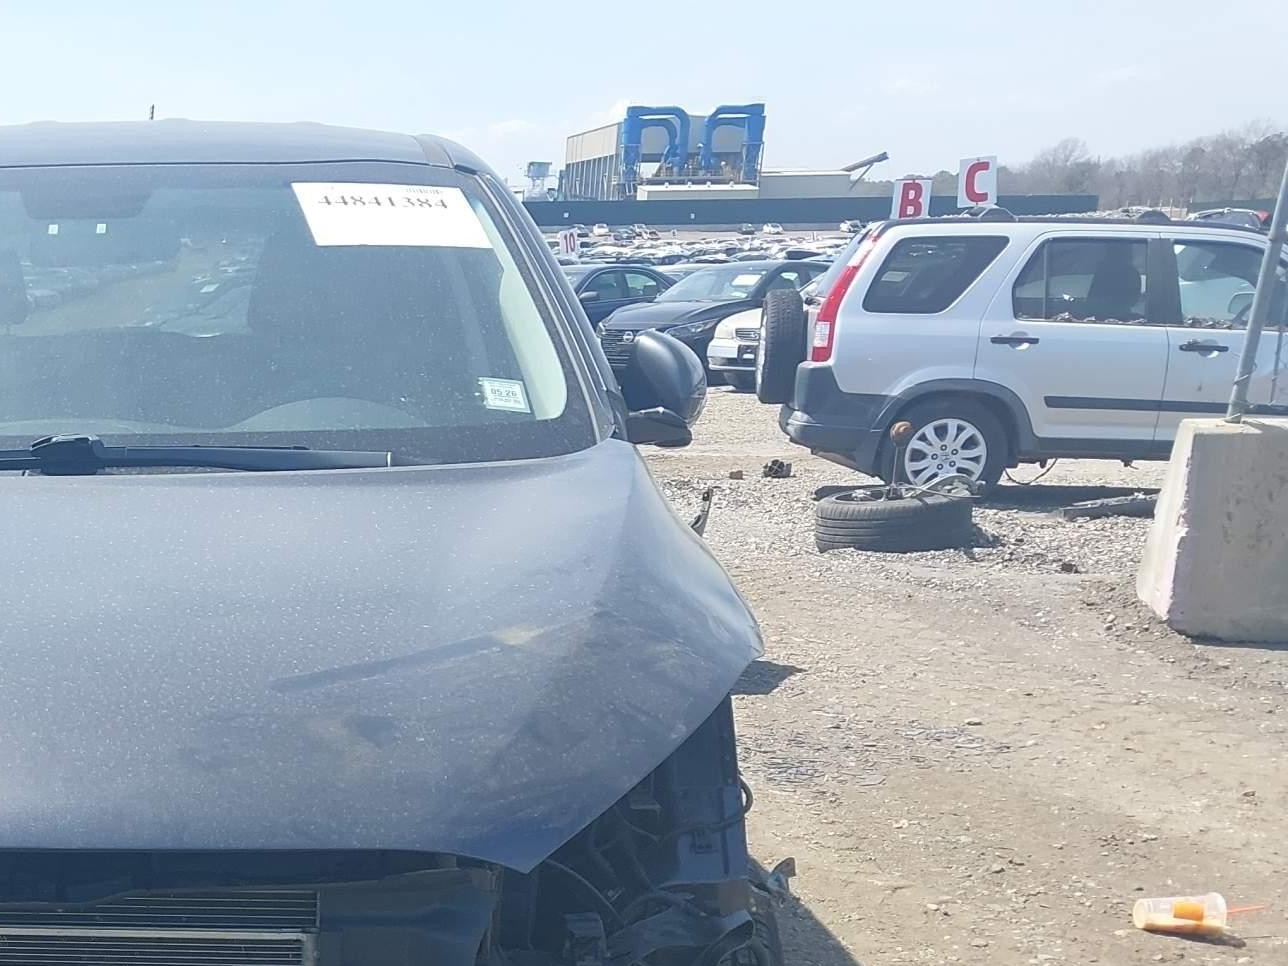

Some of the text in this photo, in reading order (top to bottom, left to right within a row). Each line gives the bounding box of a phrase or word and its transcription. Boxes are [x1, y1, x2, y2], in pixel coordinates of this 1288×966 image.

[965, 161, 990, 203] C
[318, 195, 448, 209] 44841384
[899, 182, 923, 219] B
[564, 232, 576, 253] 10
